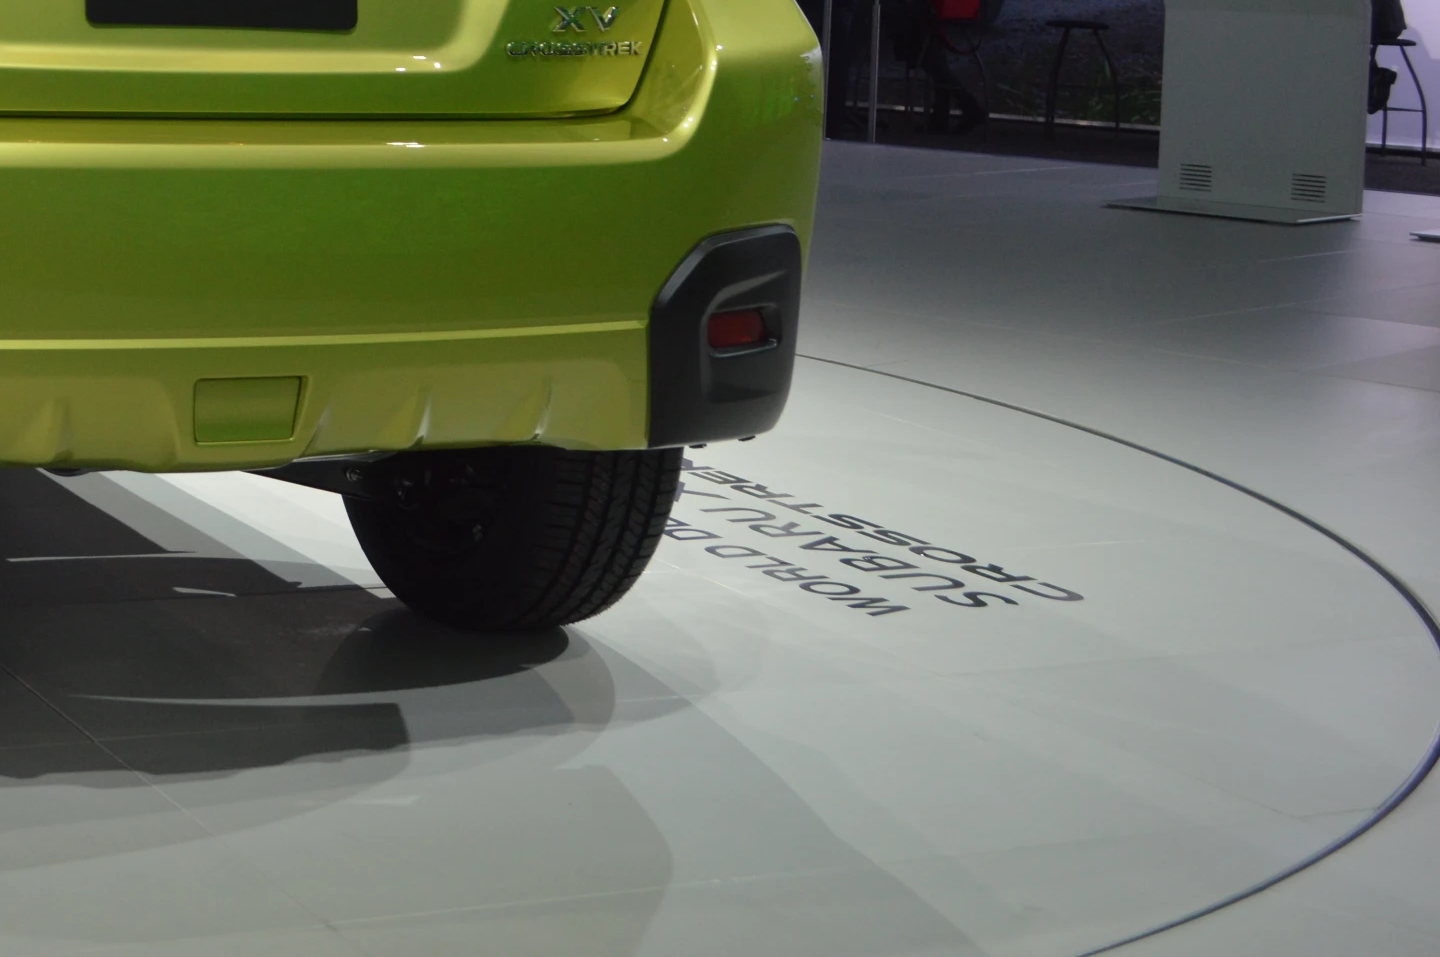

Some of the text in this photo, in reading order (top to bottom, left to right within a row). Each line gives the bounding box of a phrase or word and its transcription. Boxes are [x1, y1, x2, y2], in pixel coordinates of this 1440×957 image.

[552, 6, 621, 32] XV
[506, 41, 644, 56] CROSSTREK
[699, 507, 1019, 607] SUBARU
[704, 545, 910, 617] WORLD
